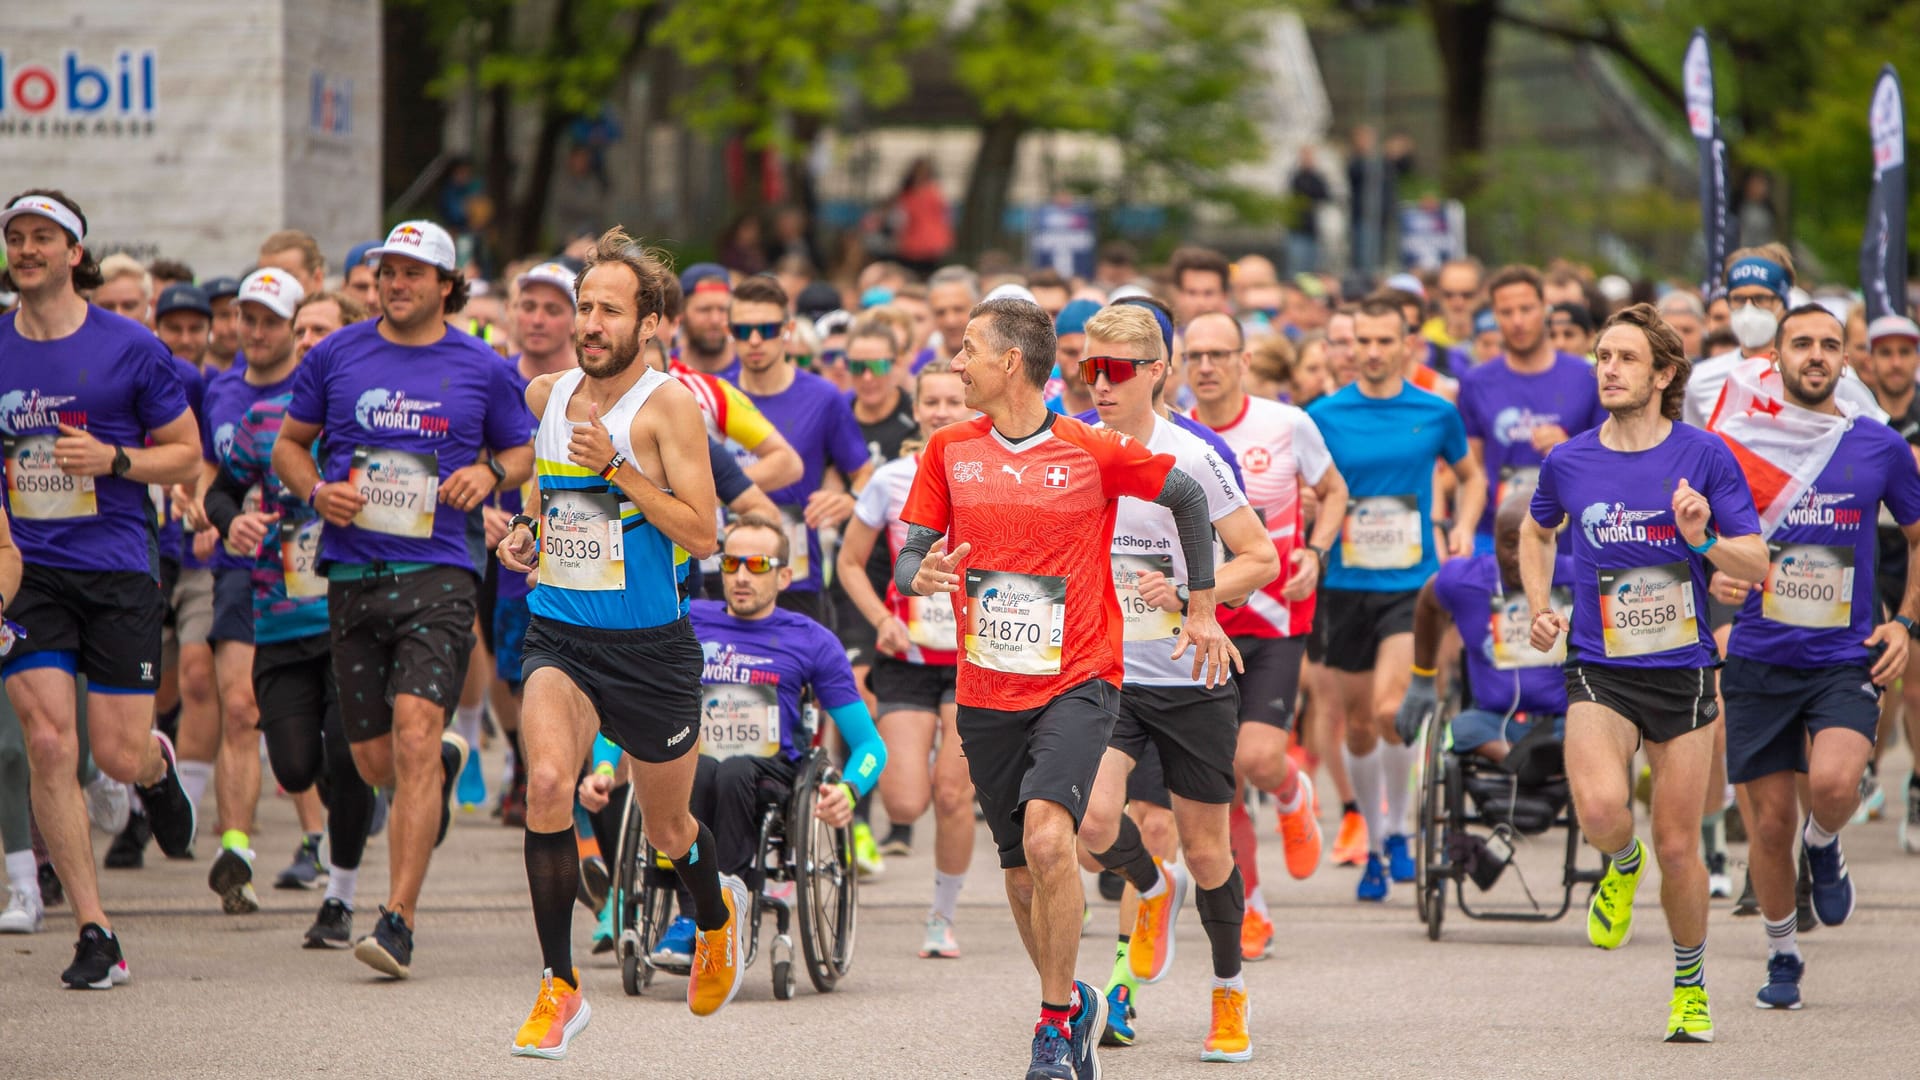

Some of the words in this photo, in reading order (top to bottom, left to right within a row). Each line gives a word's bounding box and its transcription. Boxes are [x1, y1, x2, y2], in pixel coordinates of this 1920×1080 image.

[0, 53, 155, 113] obil
[1732, 264, 1769, 281] GORE
[16, 475, 74, 493] 65988
[1203, 453, 1235, 500] salomon
[360, 486, 418, 509] 60997
[546, 535, 601, 560] 50339
[612, 543, 620, 557] 1
[1113, 535, 1171, 550] rtShop.ch
[560, 559, 581, 568] Frank
[1000, 591, 1031, 602] WINGS
[1775, 579, 1834, 602] 58600
[1615, 604, 1677, 629] 36558
[1686, 602, 1692, 614] 1
[978, 617, 1041, 644] 21870
[1051, 628, 1062, 643] 2
[1631, 626, 1666, 636] Christian
[990, 640, 1023, 652] Raphael
[667, 725, 690, 747] HOKA
[703, 724, 760, 742] 19155
